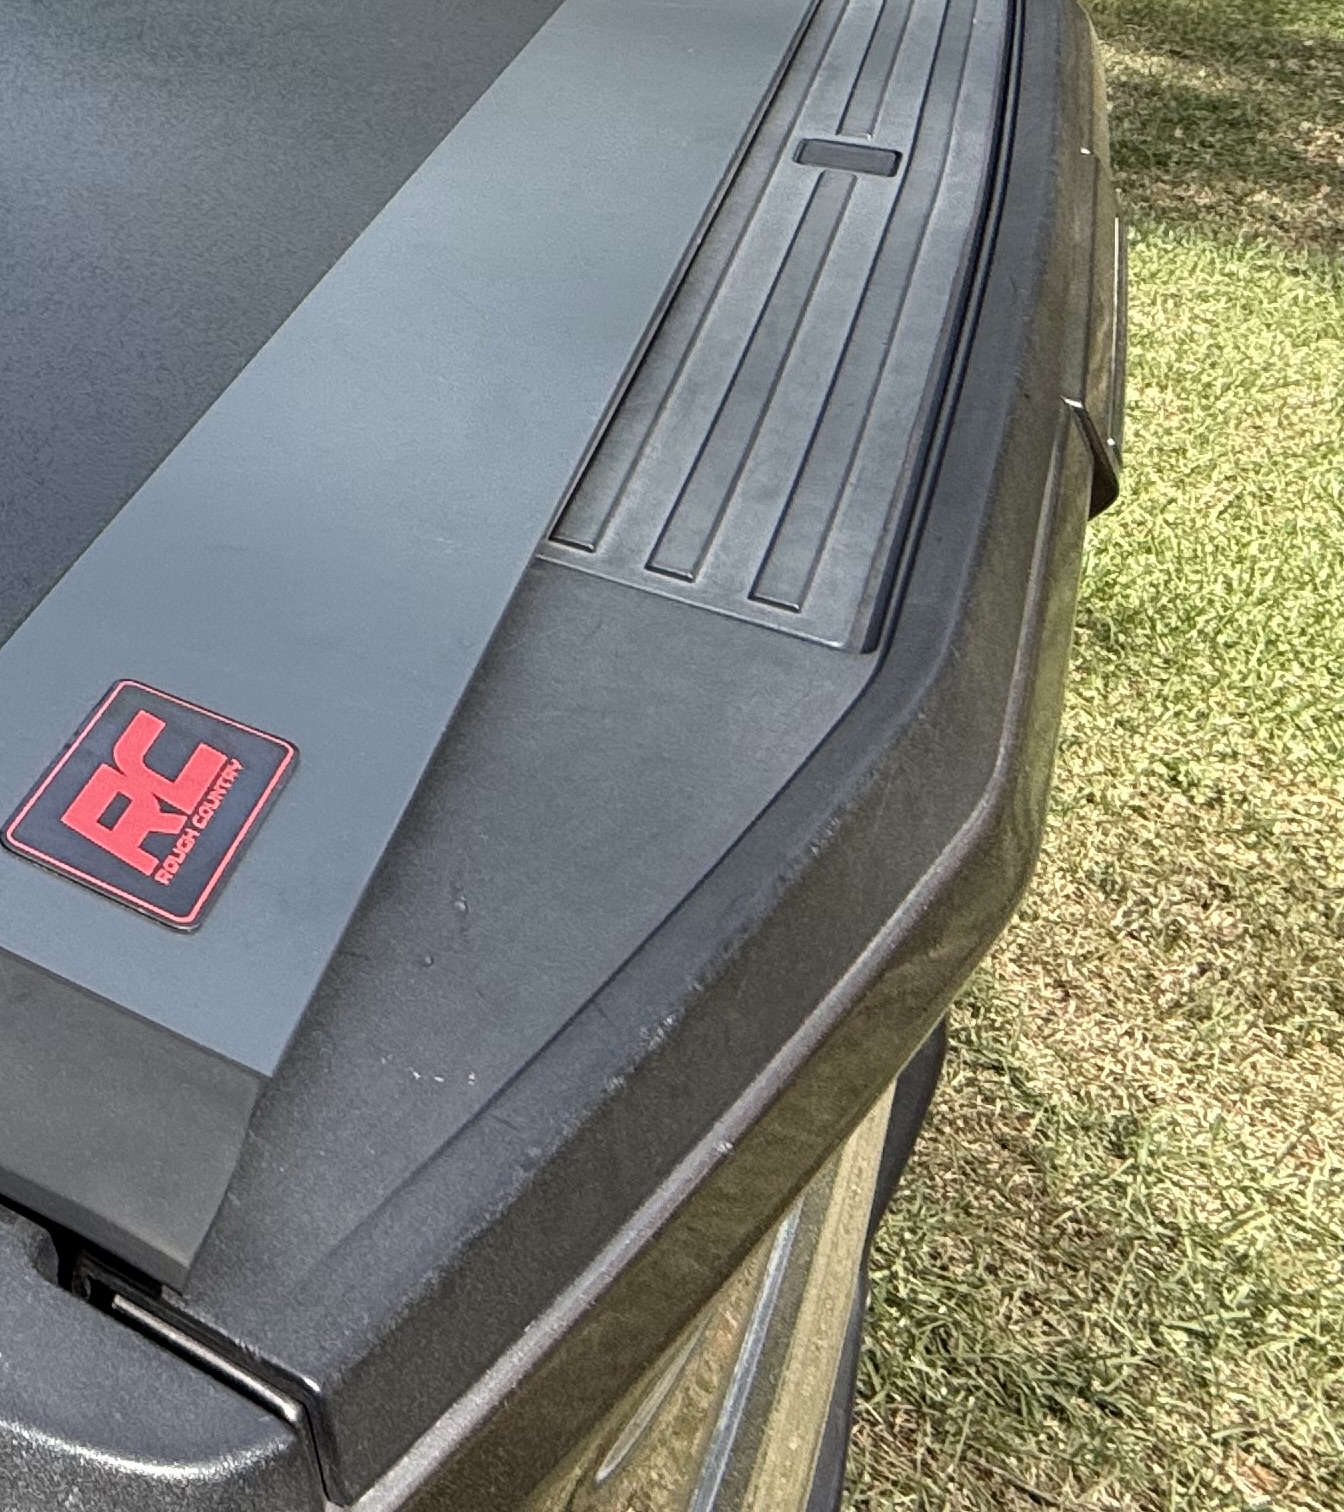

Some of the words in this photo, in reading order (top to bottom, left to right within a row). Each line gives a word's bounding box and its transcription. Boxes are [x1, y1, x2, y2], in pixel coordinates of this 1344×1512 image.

[60, 708, 229, 877] RC
[154, 827, 201, 886] ROUGH
[192, 758, 244, 830] COUNTRY
